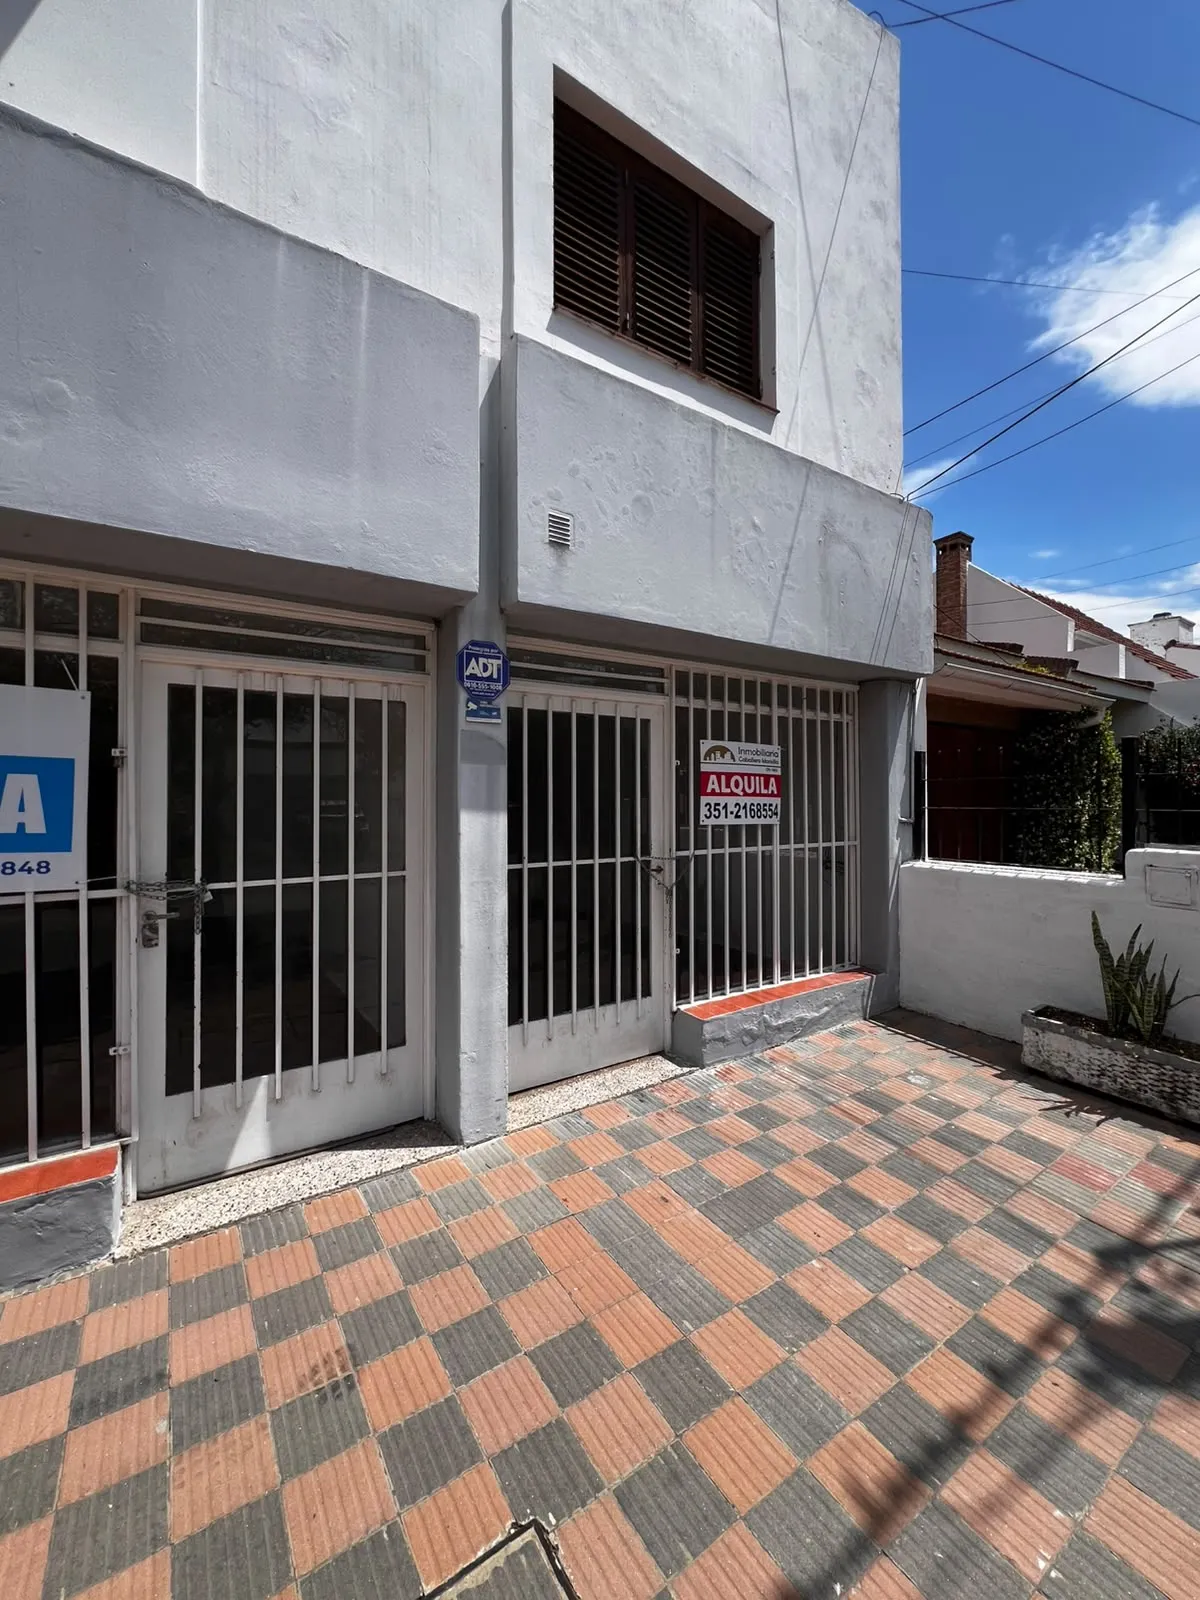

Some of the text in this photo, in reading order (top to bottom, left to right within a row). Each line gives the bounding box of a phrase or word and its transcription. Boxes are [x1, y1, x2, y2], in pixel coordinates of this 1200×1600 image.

[465, 657, 502, 679] ADT
[738, 746, 779, 758] Inmobiliaria
[706, 774, 778, 796] ALQUILA
[0, 773, 47, 834] A
[704, 802, 779, 819] 351-2168554
[0, 860, 51, 876] 848
